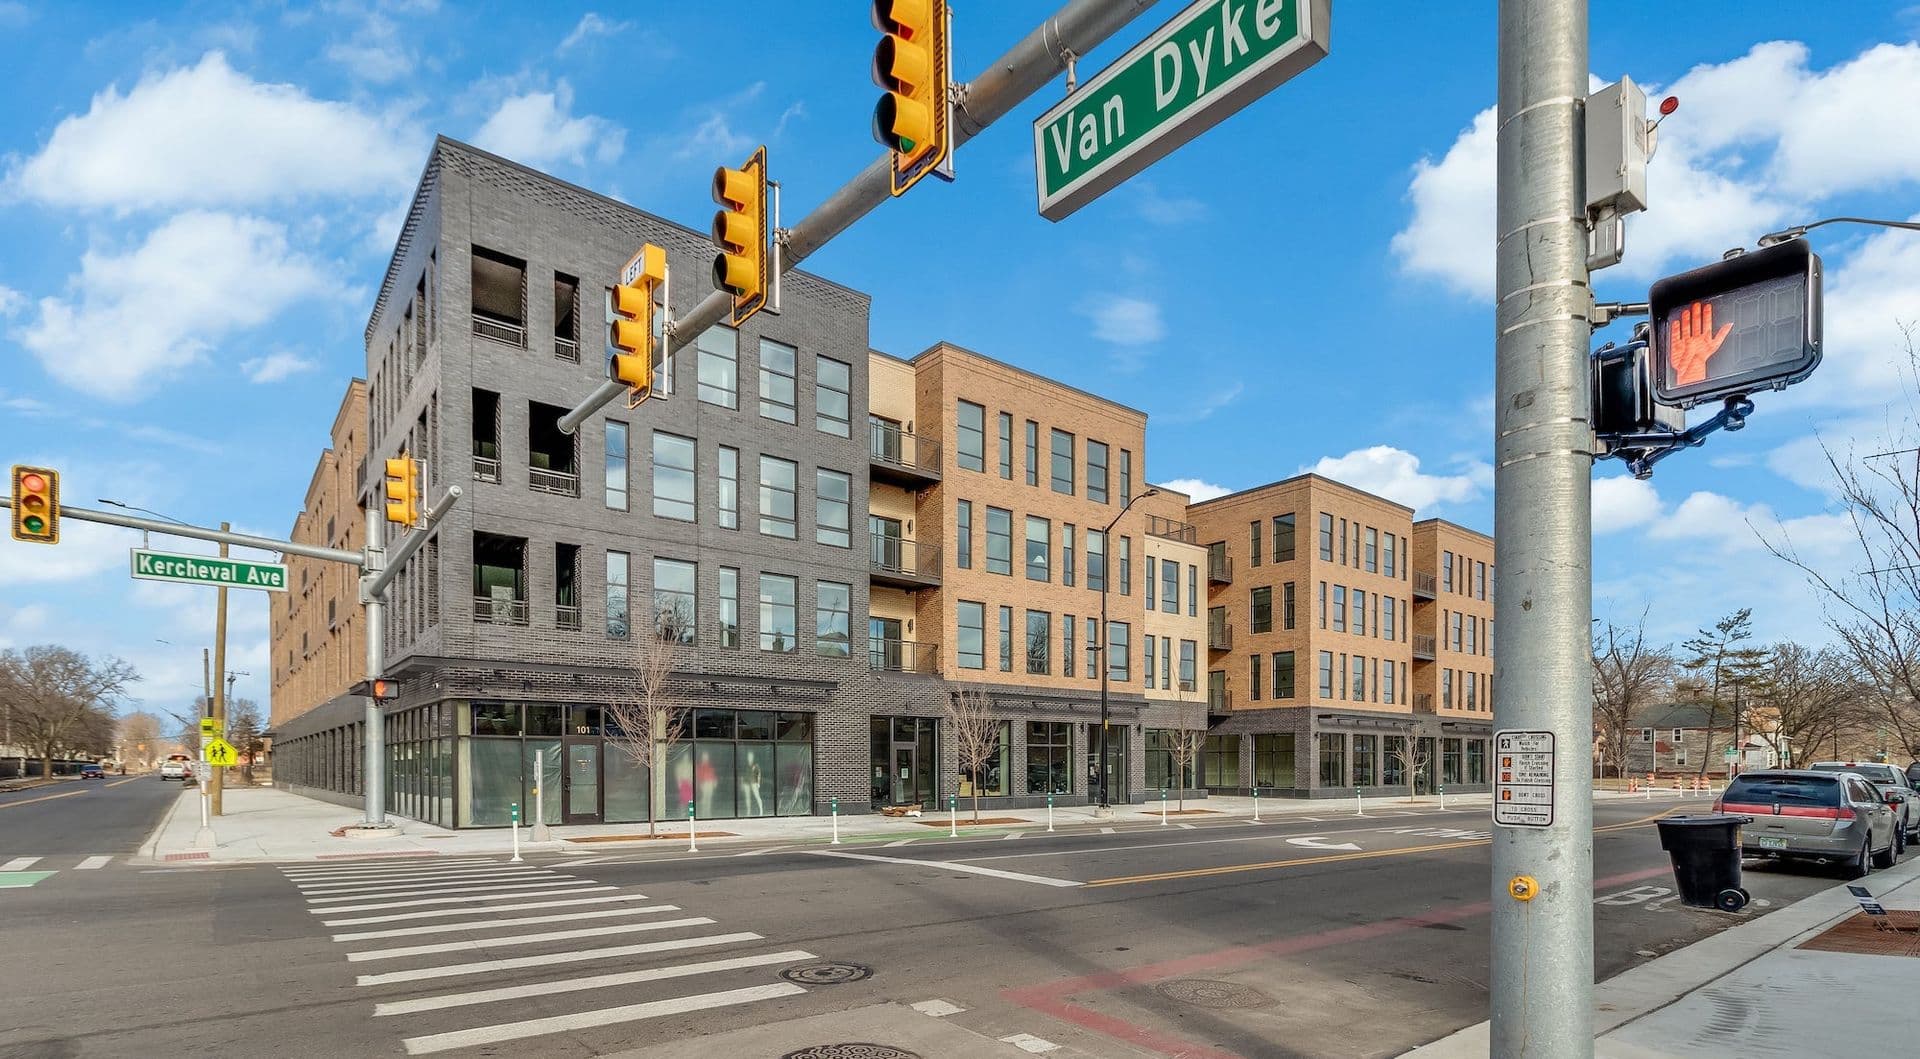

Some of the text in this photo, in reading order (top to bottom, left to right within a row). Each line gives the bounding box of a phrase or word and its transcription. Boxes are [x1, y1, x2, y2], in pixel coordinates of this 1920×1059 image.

[1050, 0, 1284, 175] Van Dyke
[625, 256, 642, 286] LEFT
[138, 554, 281, 586] Kercheval Ave
[576, 726, 591, 734] 101
